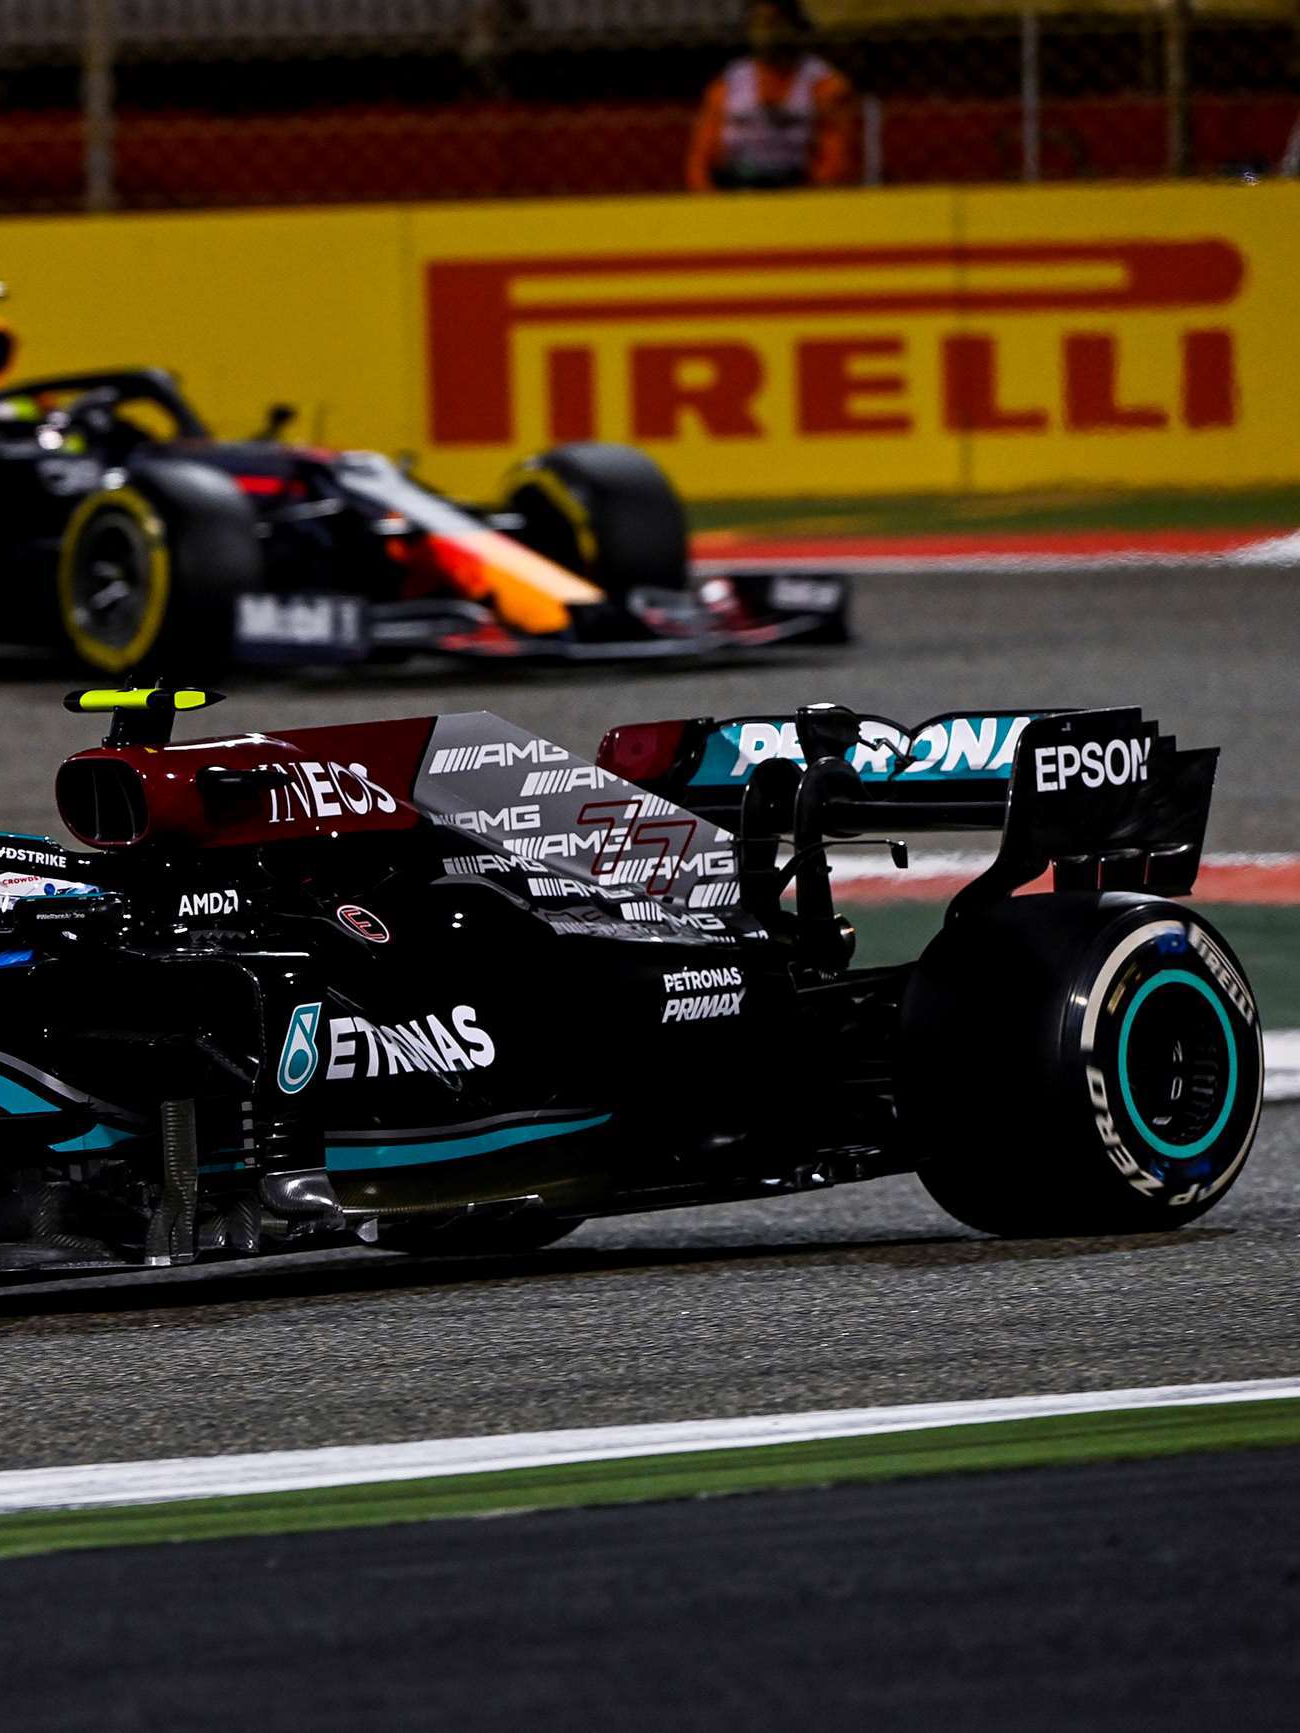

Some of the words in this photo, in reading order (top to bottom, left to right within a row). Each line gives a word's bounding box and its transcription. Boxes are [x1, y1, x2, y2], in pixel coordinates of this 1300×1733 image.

[426, 237, 1246, 447] PIRELLI
[475, 739, 569, 768] AMG
[1035, 737, 1151, 792] EPSON
[258, 761, 397, 823] INEOS
[454, 804, 541, 834] AMG
[538, 827, 632, 860] AMG
[576, 799, 699, 896] 77
[476, 854, 549, 874] AMG
[640, 850, 735, 881] AMG
[178, 891, 222, 917] AMD
[663, 966, 743, 993] PETRONAS
[661, 987, 747, 1024] PRIMAX
